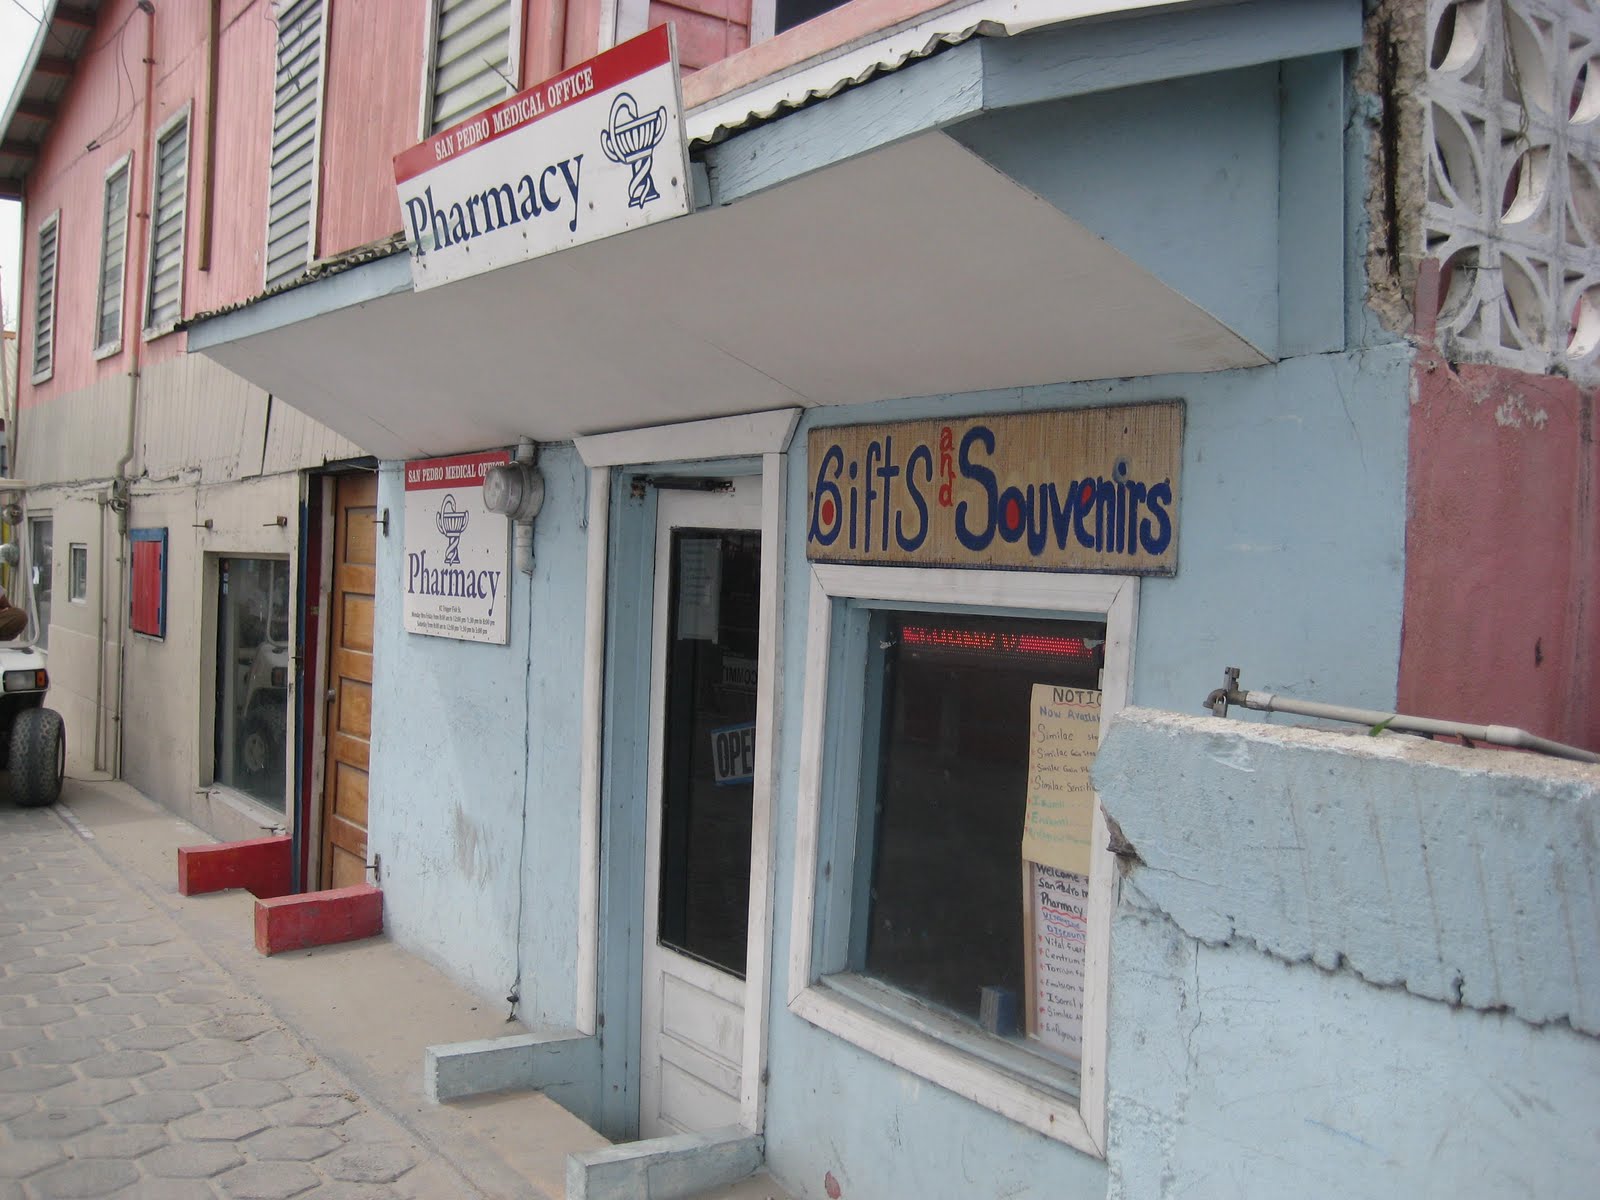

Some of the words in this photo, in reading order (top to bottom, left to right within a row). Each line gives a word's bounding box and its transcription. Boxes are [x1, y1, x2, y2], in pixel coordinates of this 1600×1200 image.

[435, 137, 454, 160] SAN
[456, 118, 490, 151] PEDRO
[493, 95, 545, 133] MEDICAL
[547, 67, 594, 107] OFFICE
[405, 153, 584, 257] Pharmacy
[408, 469, 421, 483] SAN
[422, 467, 444, 481] PEDRO
[445, 464, 477, 480] MEDICAL
[955, 425, 1173, 556] Souvenirs
[407, 550, 501, 617] Pharmacy
[1053, 687, 1102, 707] NOTIC
[1037, 723, 1074, 743] Similac
[717, 728, 755, 778] OPE
[1033, 775, 1063, 791] Similac
[1038, 877, 1055, 890] San
[1040, 891, 1083, 917] Pharmacy
